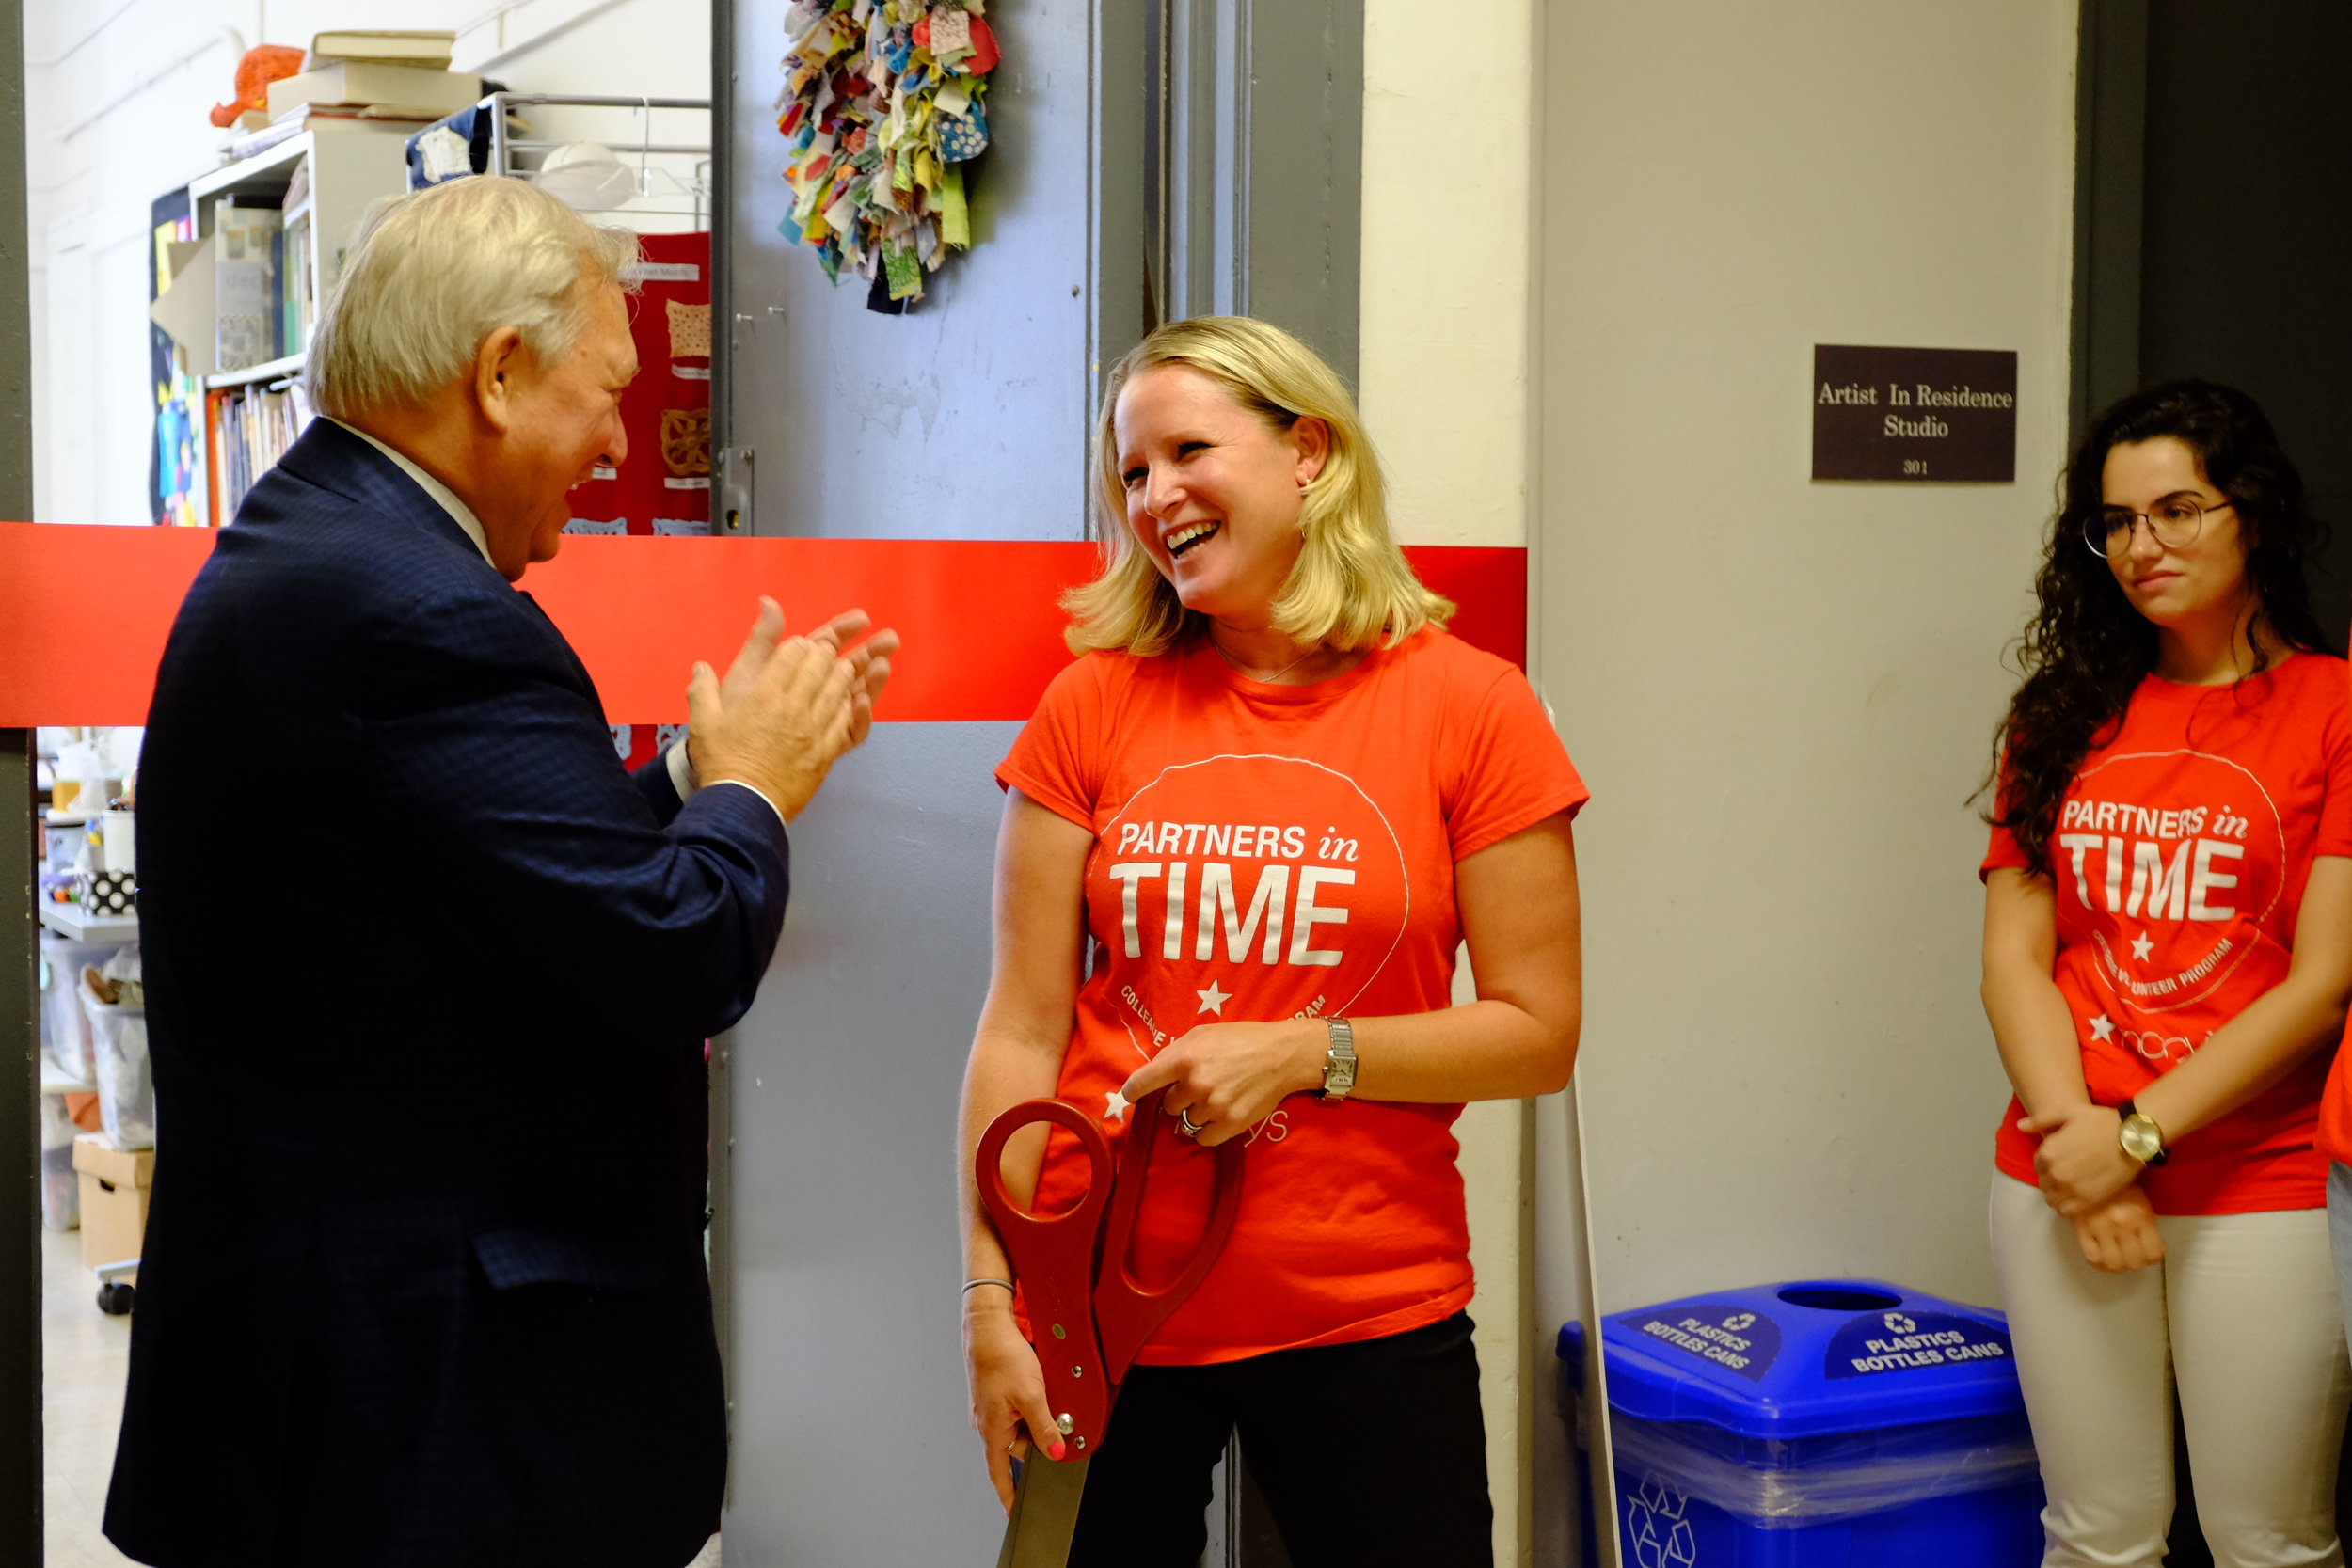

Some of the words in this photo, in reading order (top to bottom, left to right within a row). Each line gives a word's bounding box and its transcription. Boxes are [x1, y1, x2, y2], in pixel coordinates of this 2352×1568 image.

[1818, 382, 1878, 405] Artist
[1889, 383, 1911, 406] In
[1915, 384, 2013, 408] Residence
[1883, 414, 1949, 438] Studio
[1903, 459, 1928, 475] 301
[2062, 800, 2208, 839] PARTNERS
[2213, 805, 2249, 839] in
[1117, 821, 1305, 858] PARTNERS
[1318, 826, 1359, 862] in
[2059, 833, 2245, 921] TIME
[1109, 862, 1356, 966] TIME
[2178, 937, 2233, 987] PROGRAM
[1120, 985, 1167, 1047] COLLEAE
[1643, 1321, 1708, 1352] BOTTLES
[1703, 1346, 1750, 1369] CANS
[1678, 1318, 1751, 1351] PLASTICS
[1865, 1330, 1965, 1354] PLASTICS
[1851, 1349, 1944, 1372] BOTTLES
[1945, 1342, 2004, 1361] CANS
